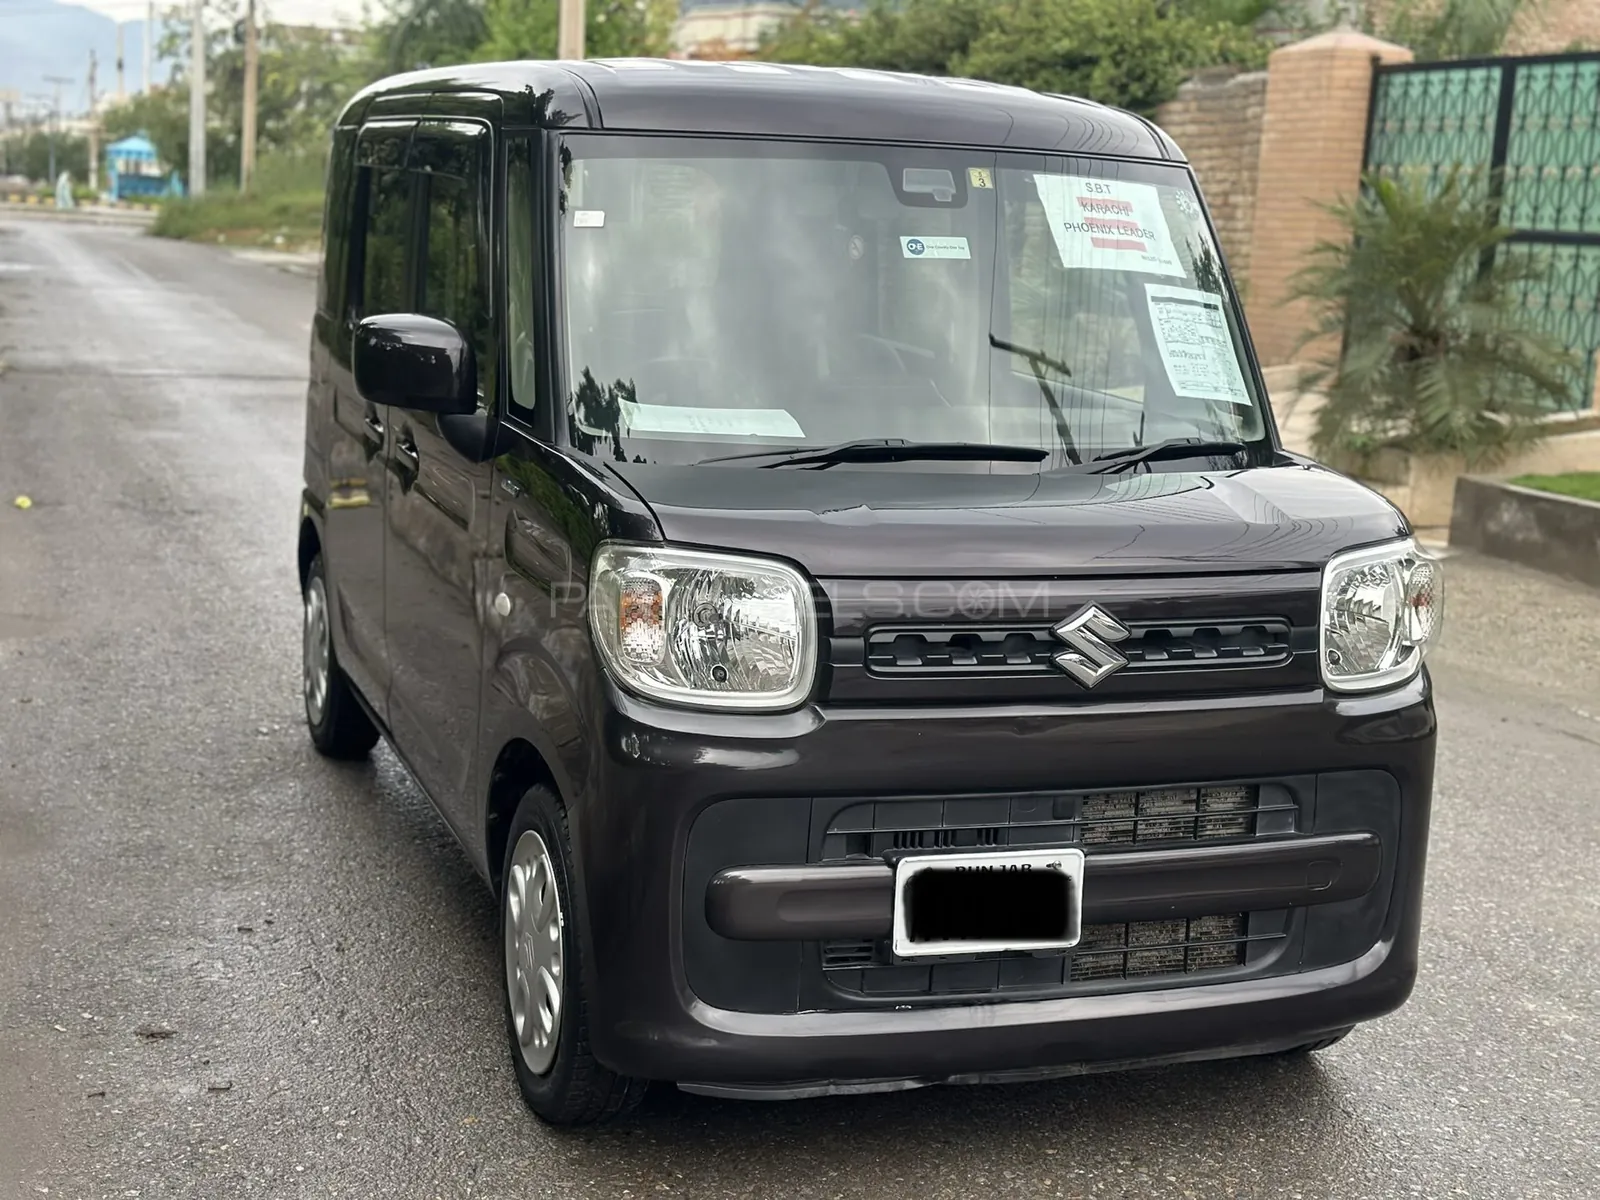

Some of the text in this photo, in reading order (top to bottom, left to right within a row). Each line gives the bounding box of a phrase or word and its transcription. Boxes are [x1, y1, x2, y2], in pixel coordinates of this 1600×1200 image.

[978, 178, 986, 188] 3
[1085, 182, 1112, 194] S.B.T
[1081, 202, 1130, 216] KARACHI
[1064, 222, 1156, 241] PHOENIX LEADER
